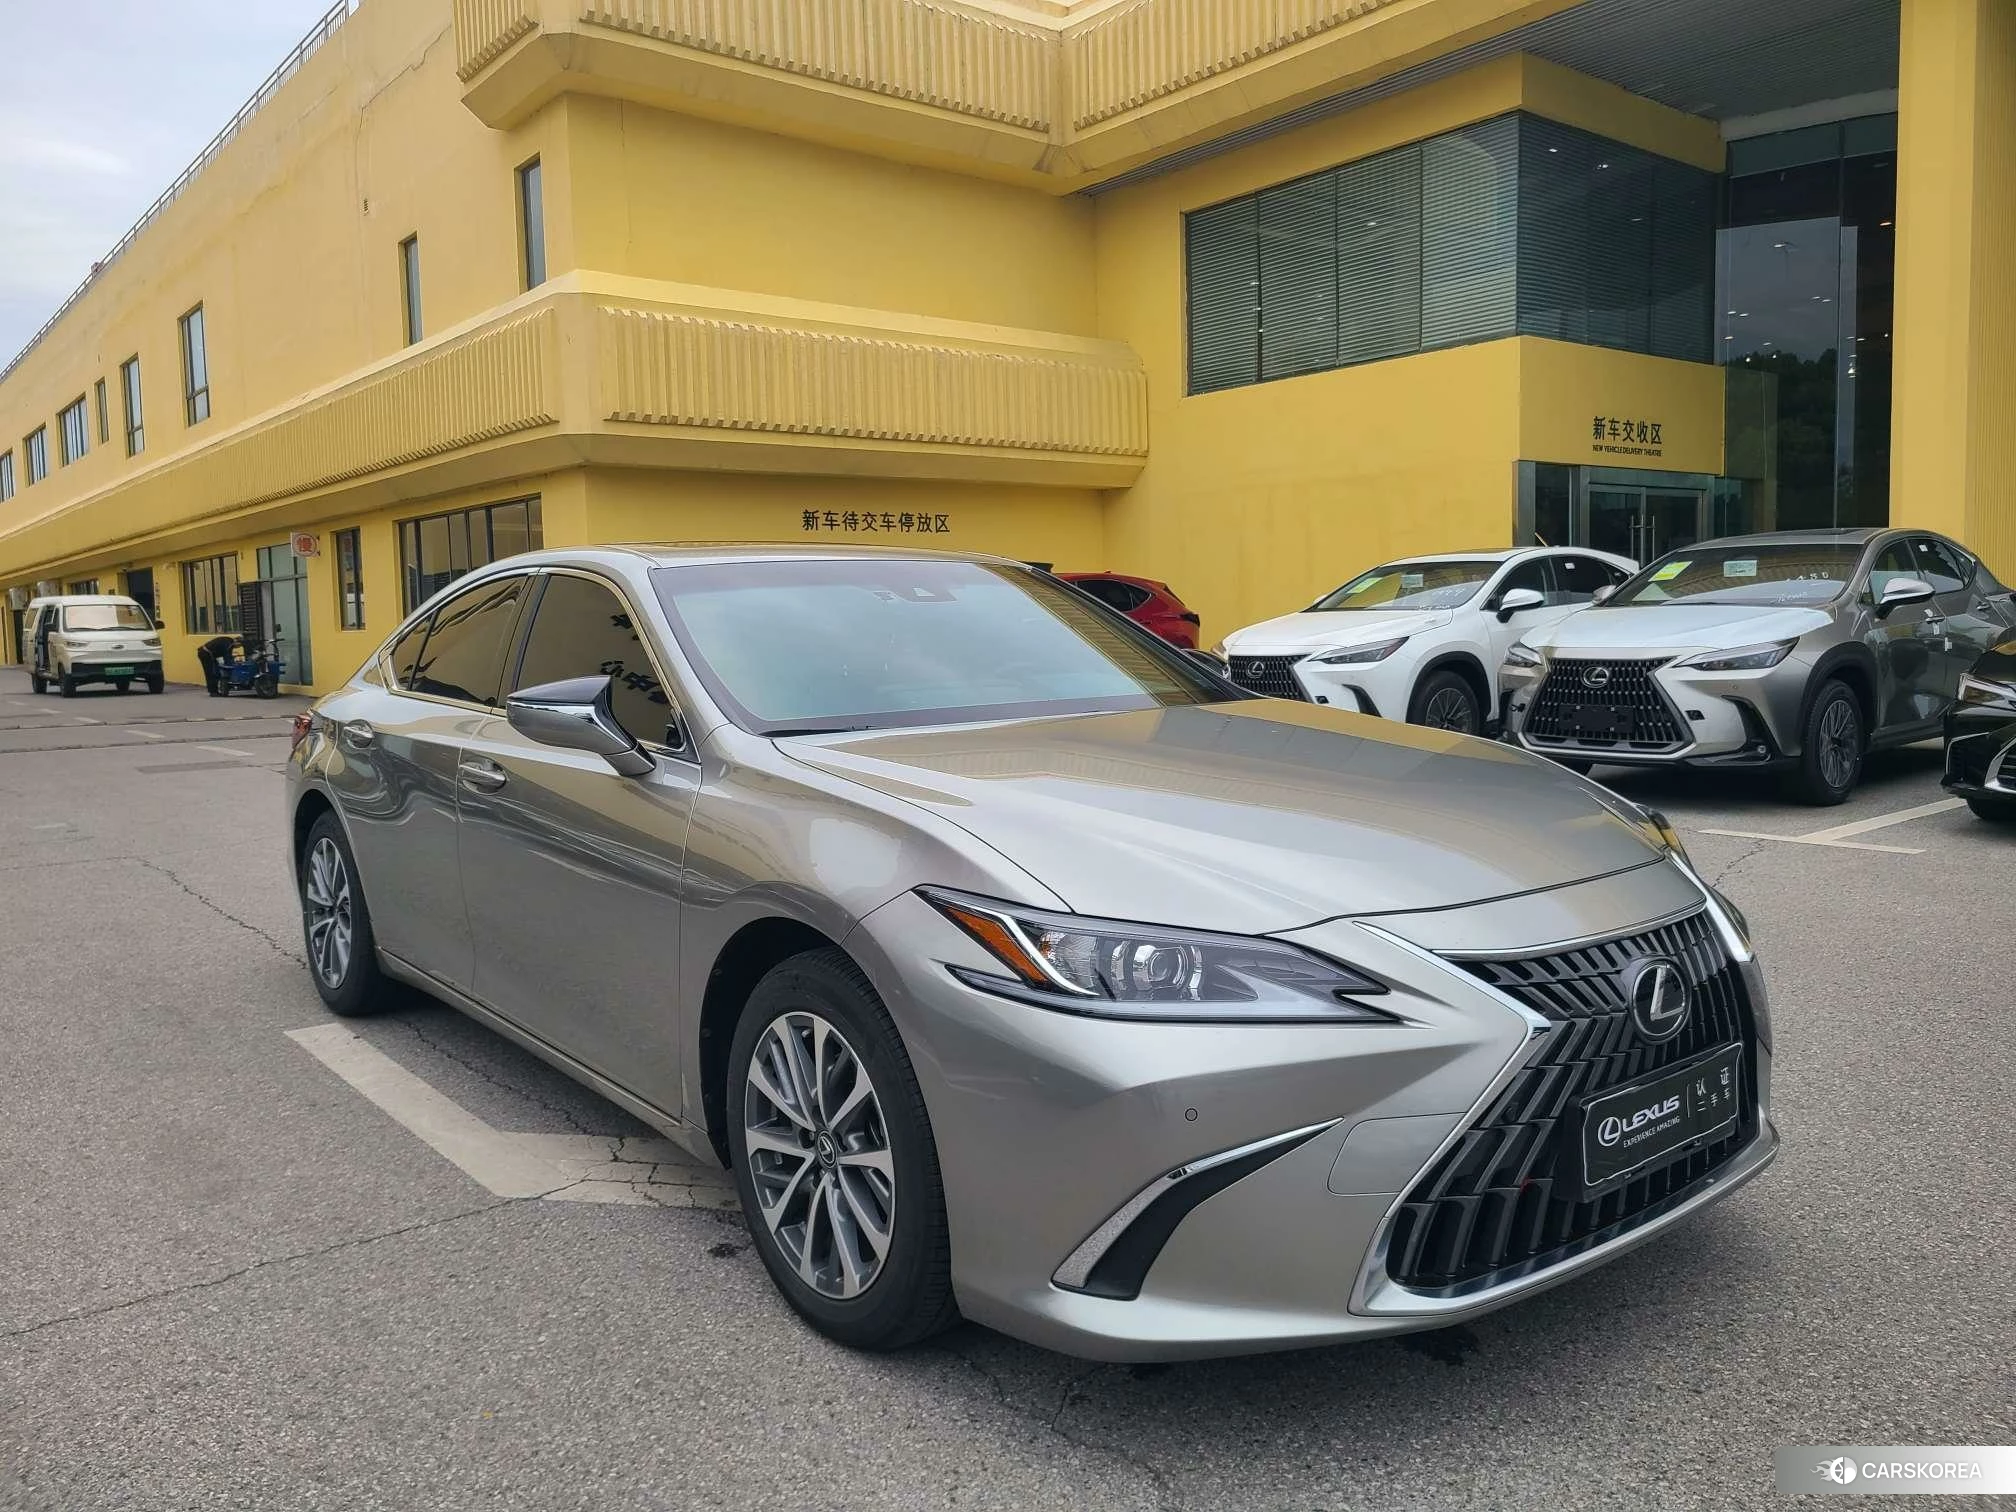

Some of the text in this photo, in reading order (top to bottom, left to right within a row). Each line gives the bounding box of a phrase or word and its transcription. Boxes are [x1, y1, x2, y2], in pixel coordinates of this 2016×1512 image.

[1593, 416, 1662, 444] 新车交收区
[1604, 445, 1623, 454] VEHICLE
[1623, 447, 1643, 455] DELIVERY
[802, 509, 950, 533] 新车待交车停放区
[1622, 1095, 1680, 1132] LEXUS
[1623, 1115, 1681, 1148] EXPERIENCE AMAZING
